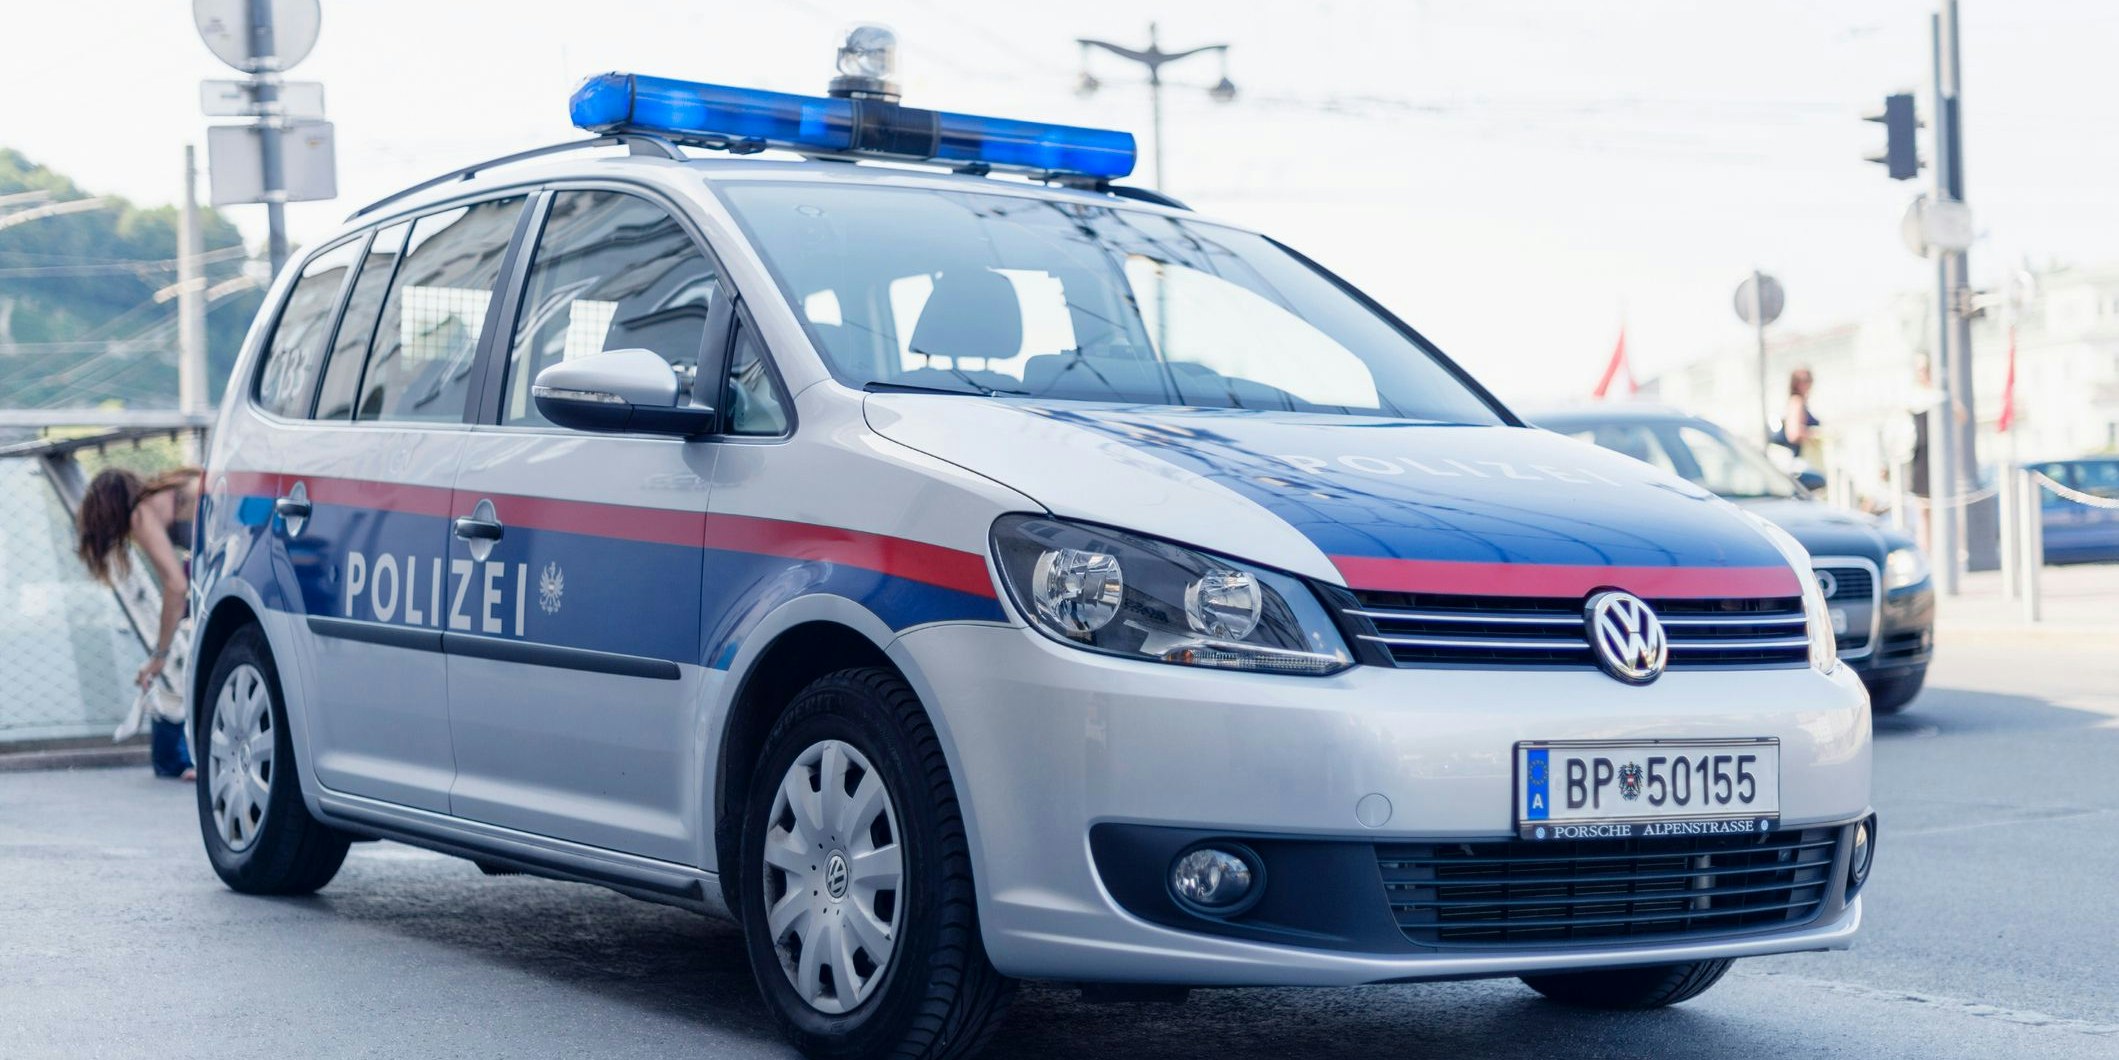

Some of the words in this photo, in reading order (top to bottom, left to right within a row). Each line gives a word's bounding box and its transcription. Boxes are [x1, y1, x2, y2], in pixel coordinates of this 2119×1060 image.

[1276, 454, 1622, 487] POLIZEI
[346, 551, 527, 636] POLIZEI
[1532, 793, 1544, 809] A
[1566, 757, 1614, 809] BP
[1647, 755, 1757, 806] 50155
[1553, 825, 1632, 839] PORSCHE
[1643, 820, 1755, 836] ALPENSTRASSE
